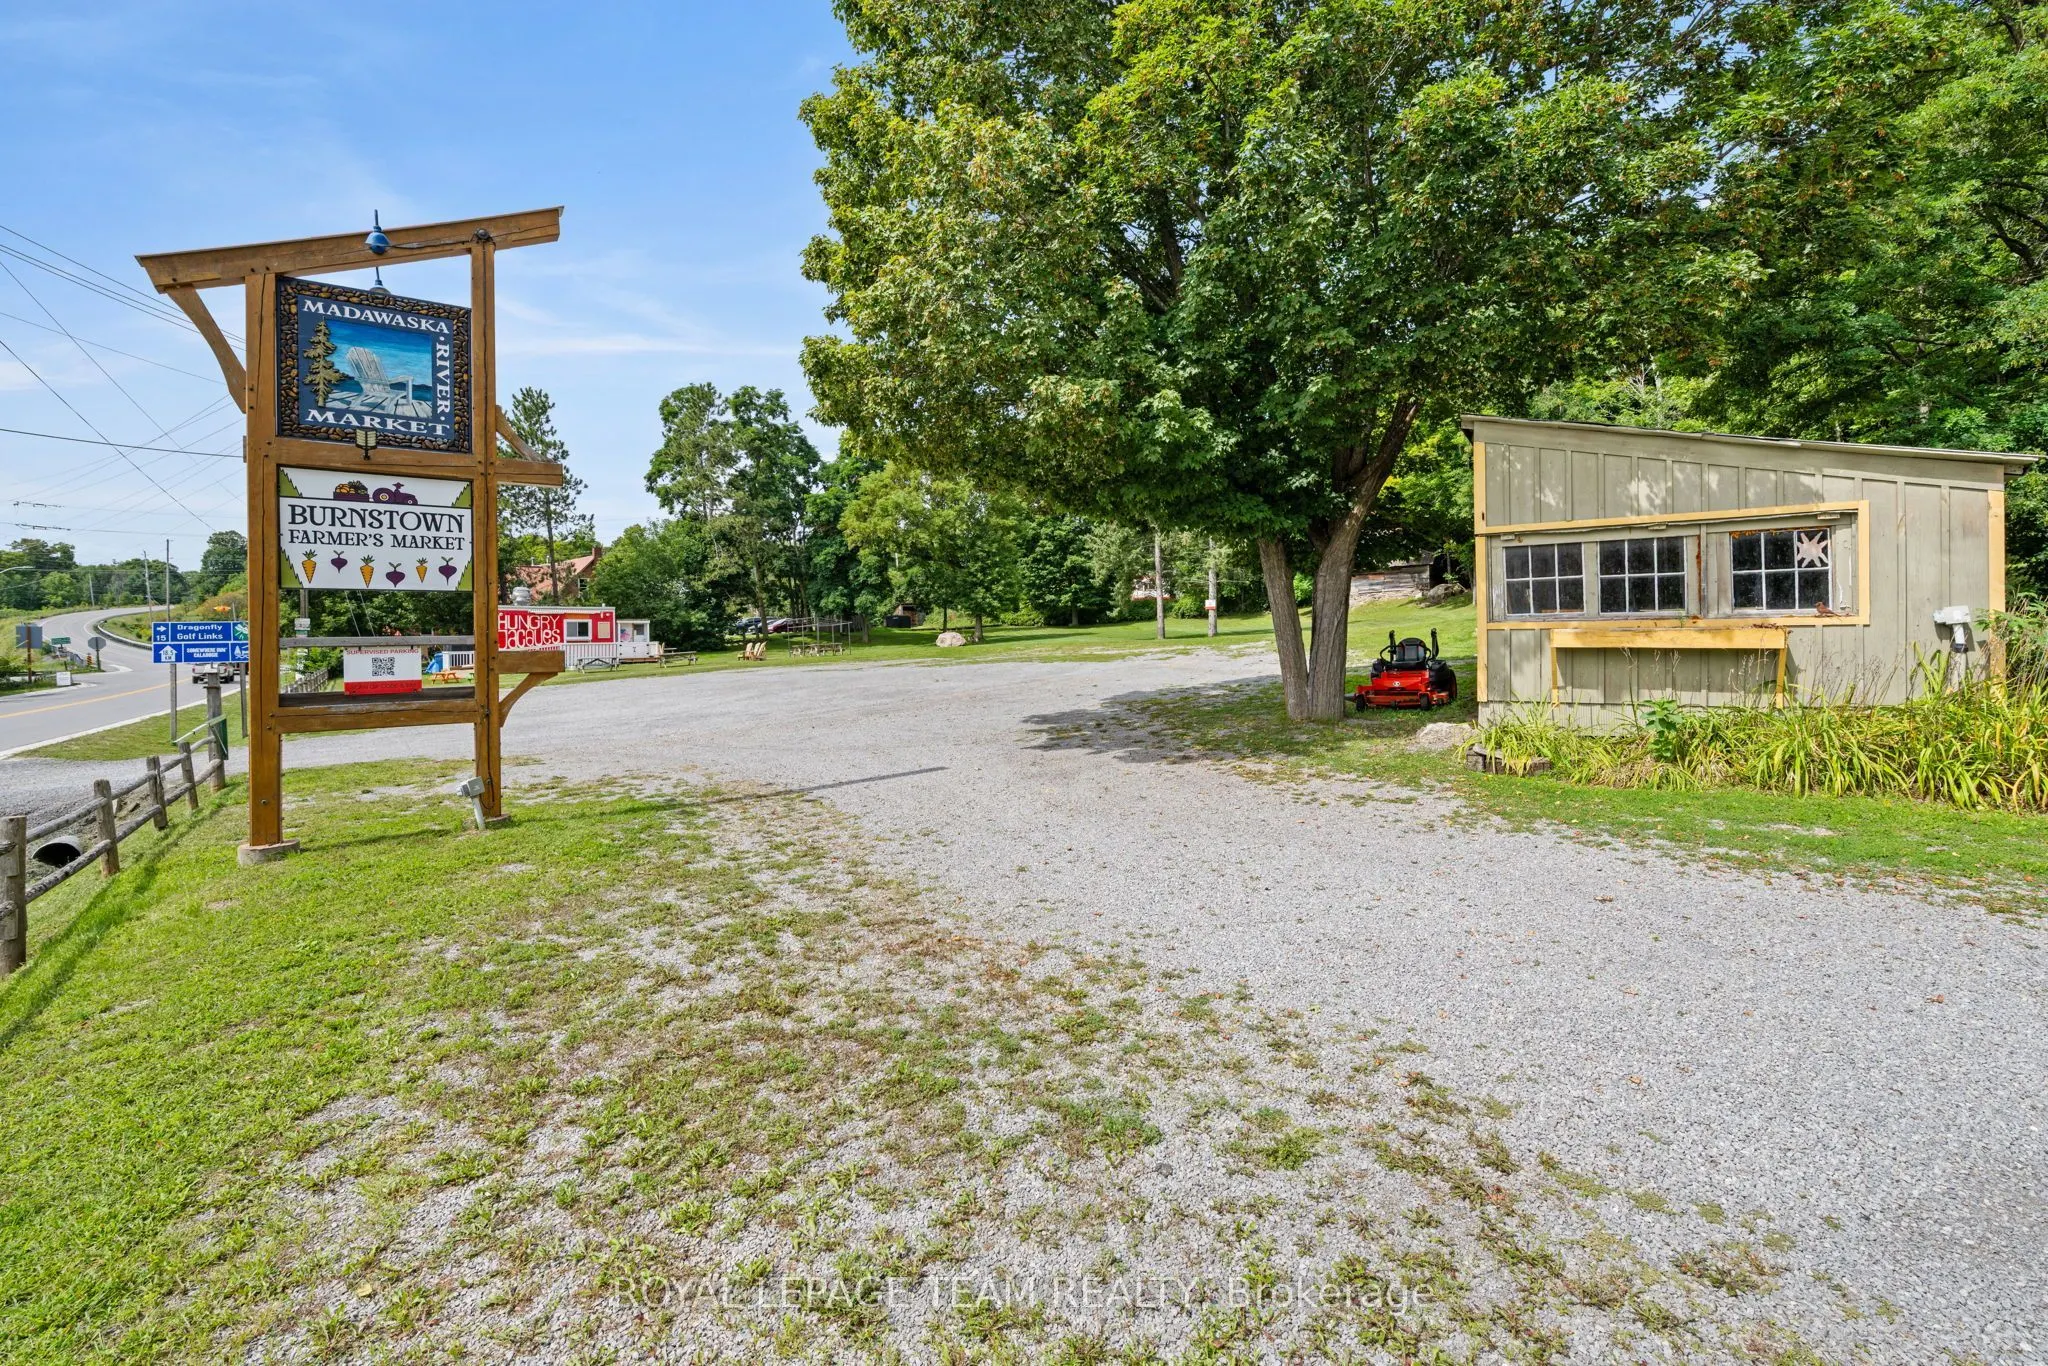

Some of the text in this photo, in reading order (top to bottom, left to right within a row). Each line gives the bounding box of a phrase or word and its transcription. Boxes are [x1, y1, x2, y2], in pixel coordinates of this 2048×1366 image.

[303, 300, 450, 333] MADAWASKA
[435, 343, 451, 414] RIVER
[305, 409, 450, 436] MARKET
[288, 504, 464, 533] BURNSTOWN
[288, 529, 465, 550] FARMER'S MARKET
[498, 612, 560, 630] HUNGRY
